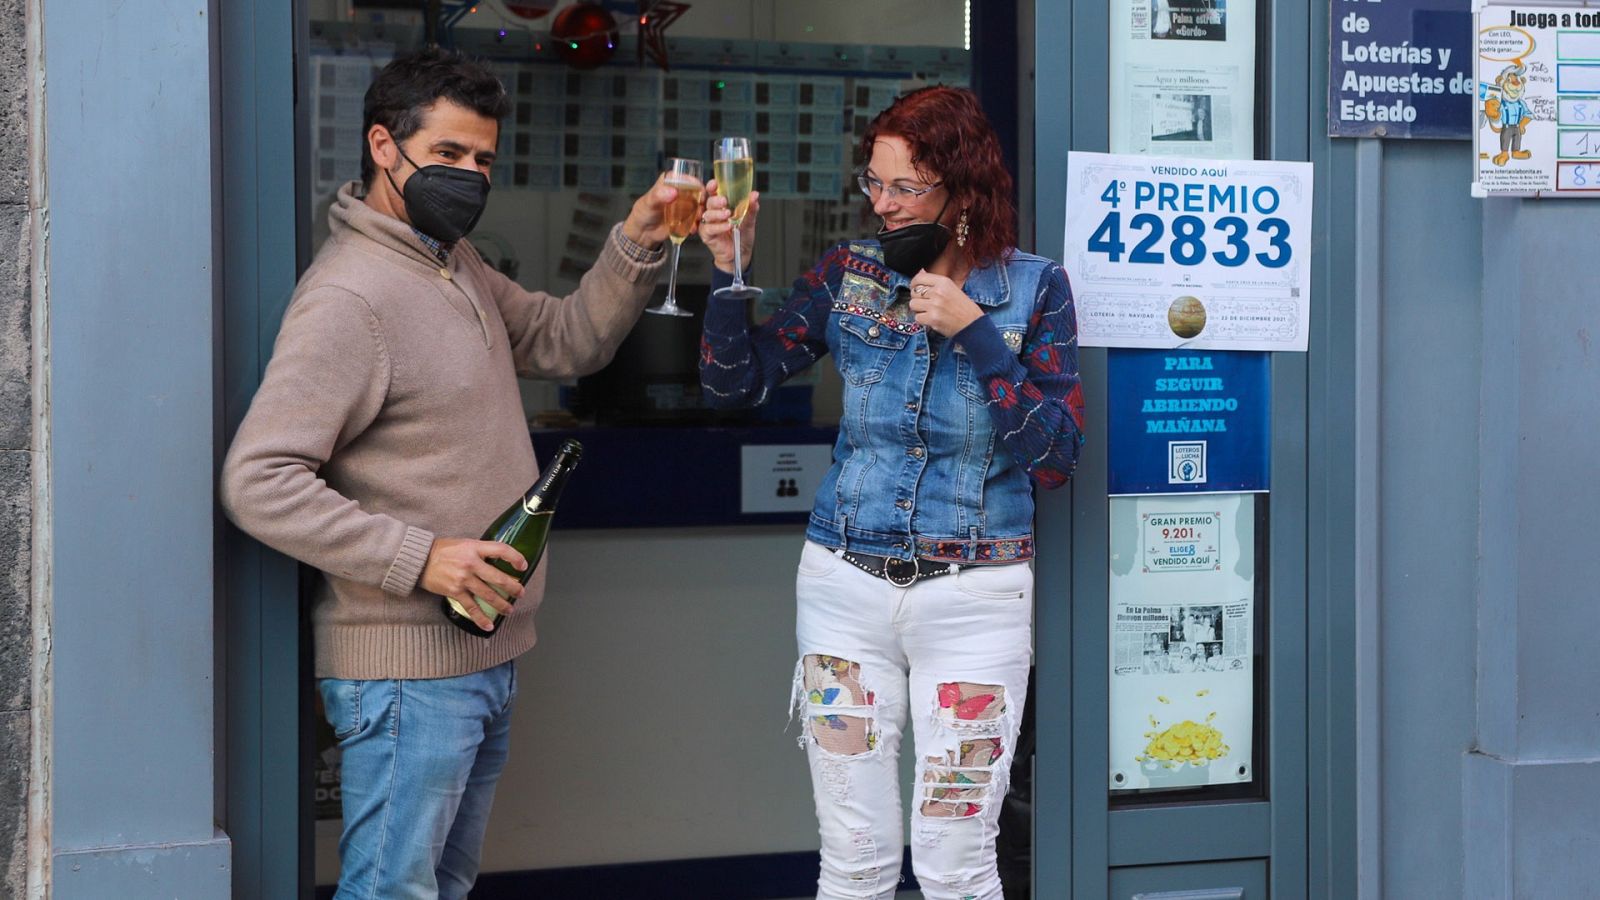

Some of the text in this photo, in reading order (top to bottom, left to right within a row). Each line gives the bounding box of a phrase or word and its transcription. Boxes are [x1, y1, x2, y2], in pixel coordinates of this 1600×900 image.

[1172, 12, 1194, 24] Palma
[1342, 13, 1370, 33] de
[1510, 10, 1557, 28] Juega
[1561, 14, 1571, 27] a
[1341, 41, 1451, 71] Loterías y
[1179, 75, 1210, 85] millones
[1341, 70, 1473, 97] Apuestas de
[1341, 100, 1417, 123] Estado
[1151, 166, 1227, 177] VENDIDO AQUÍ
[1134, 181, 1280, 215] PREMIO
[1087, 211, 1293, 269] 42833
[1164, 357, 1213, 370] PARA
[1155, 378, 1224, 392] SEGUIR
[1141, 398, 1238, 413] ABRIENDO
[1146, 417, 1227, 433] MAÑANA
[1151, 516, 1213, 526] GRAN PREMIO
[1162, 527, 1194, 539] 9.201
[1153, 555, 1210, 565] VENDIDO AQUÍ
